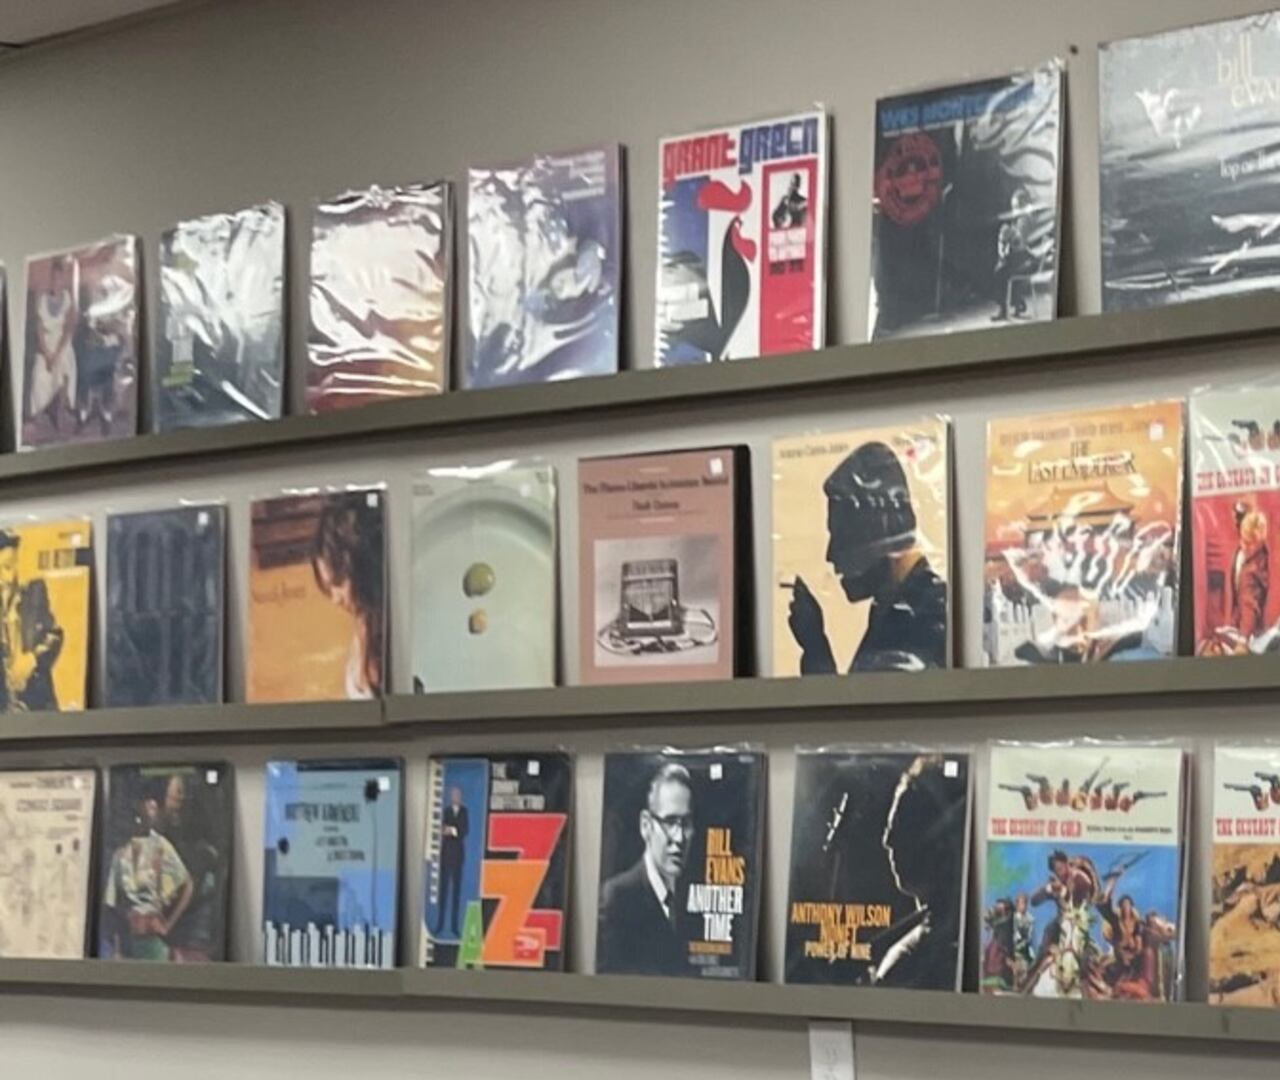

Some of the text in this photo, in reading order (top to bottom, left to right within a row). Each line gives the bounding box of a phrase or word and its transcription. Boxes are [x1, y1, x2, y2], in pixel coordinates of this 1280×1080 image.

[1216, 818, 1233, 836] THE
[706, 827, 732, 856] BILL
[705, 856, 746, 885] EVANS
[687, 884, 743, 914] ANOTHER
[703, 914, 733, 942] TIME
[791, 902, 892, 927] ANTHONY WILSON
